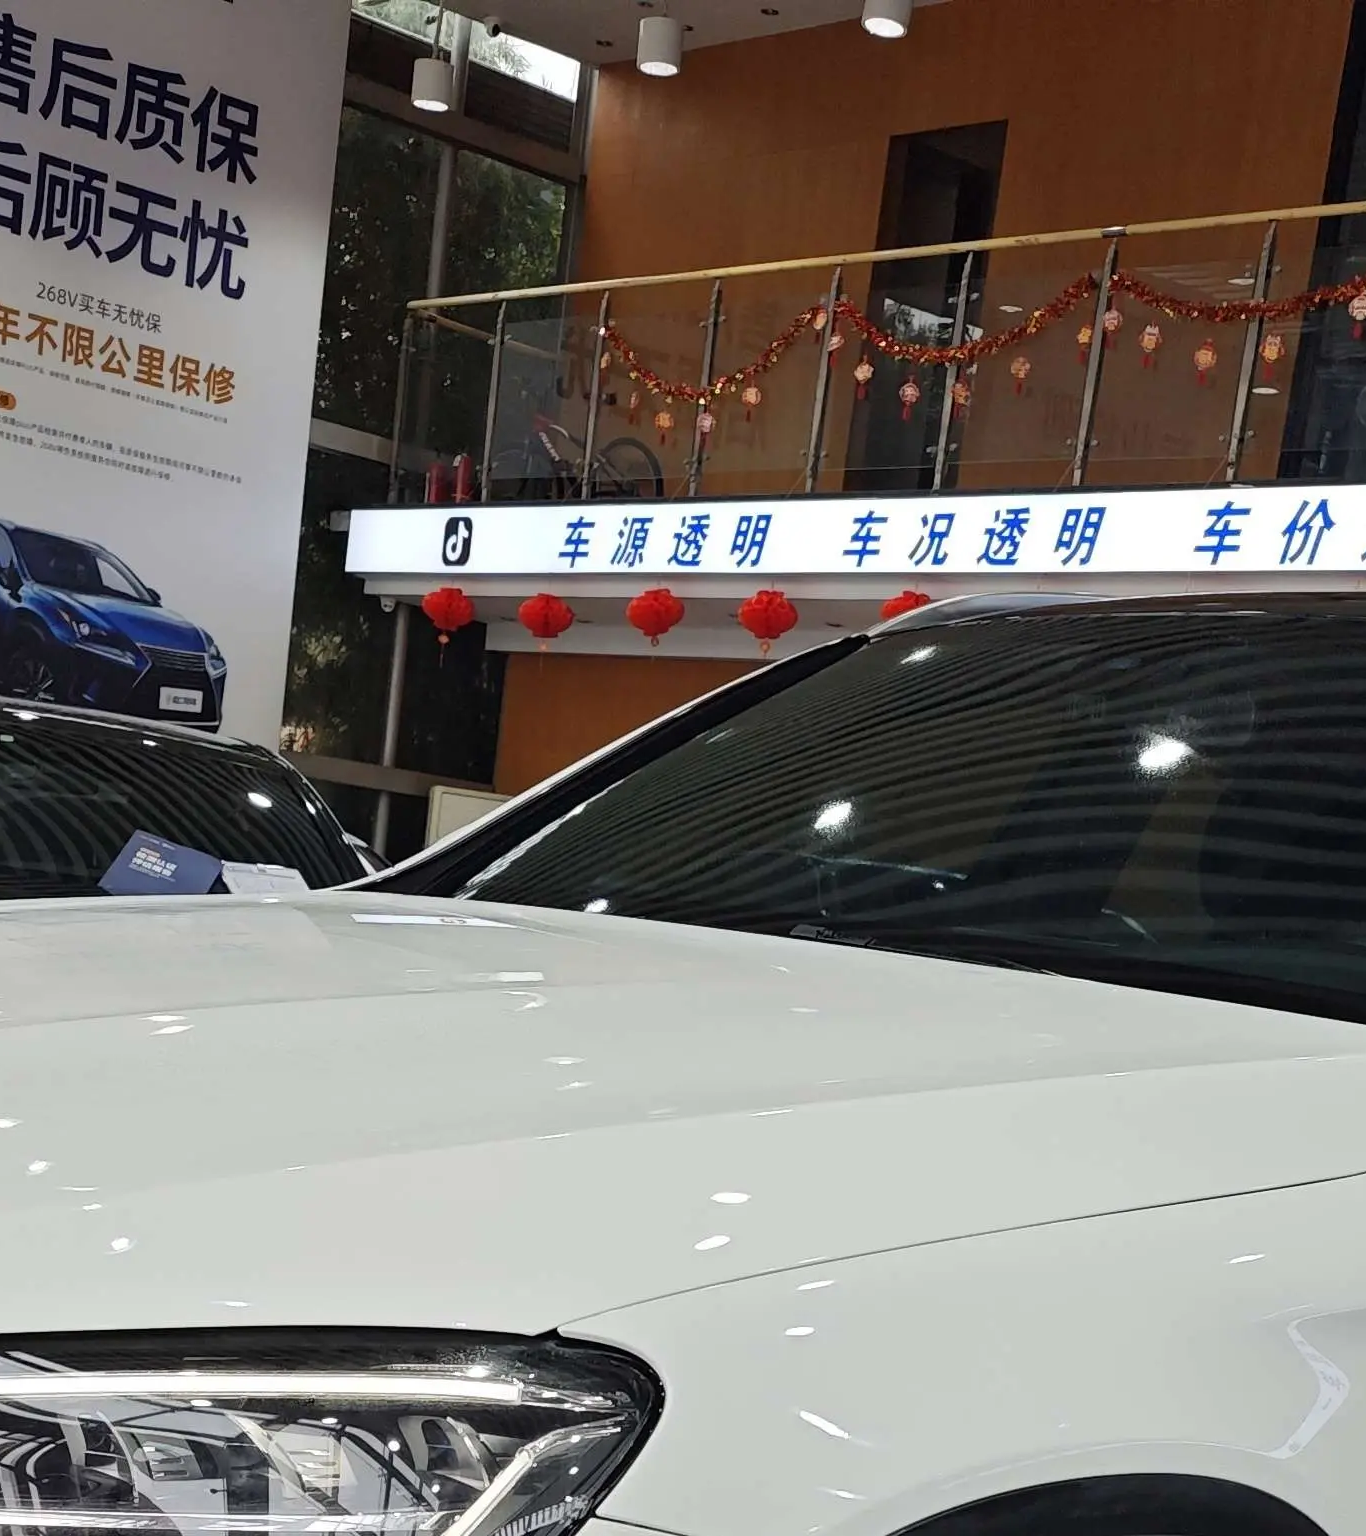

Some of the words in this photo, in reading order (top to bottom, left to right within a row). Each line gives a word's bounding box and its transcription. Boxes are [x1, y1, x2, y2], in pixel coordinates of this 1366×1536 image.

[36, 281, 162, 334] 268V买车无忧保
[557, 515, 771, 571] 车源透明
[841, 505, 1107, 570] 车况透明
